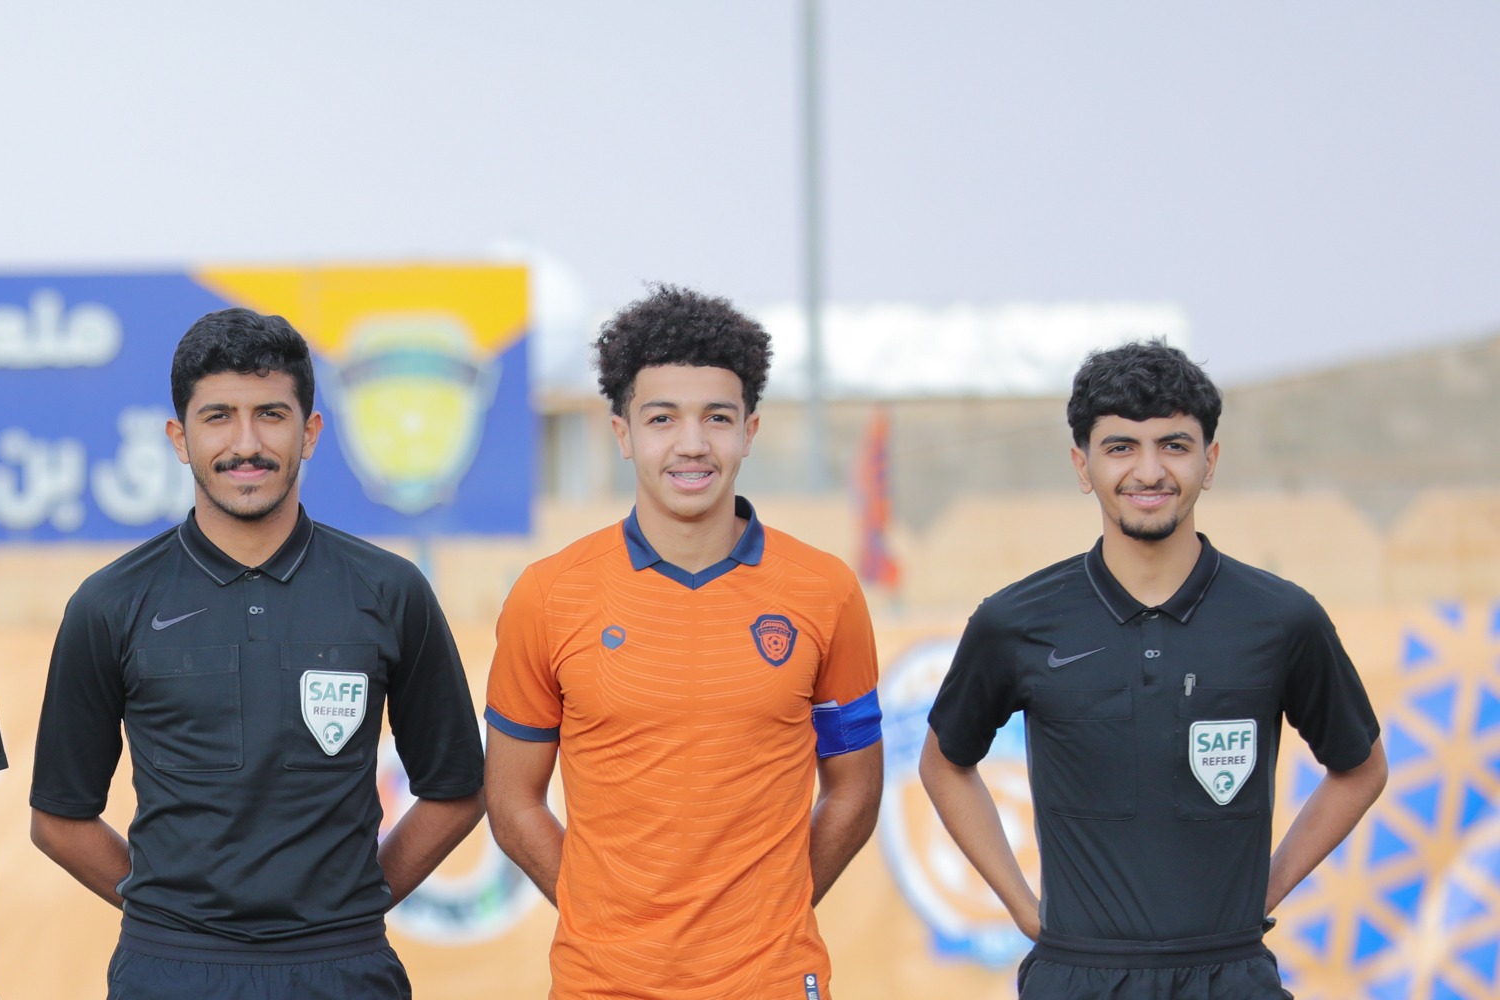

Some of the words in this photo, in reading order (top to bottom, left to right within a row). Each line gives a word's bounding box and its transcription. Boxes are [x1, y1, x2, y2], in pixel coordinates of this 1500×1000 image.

[308, 681, 363, 703] SAFF
[313, 706, 357, 718] REFEREE
[1196, 730, 1252, 753] SAFF
[1202, 755, 1247, 766] REFEREE
